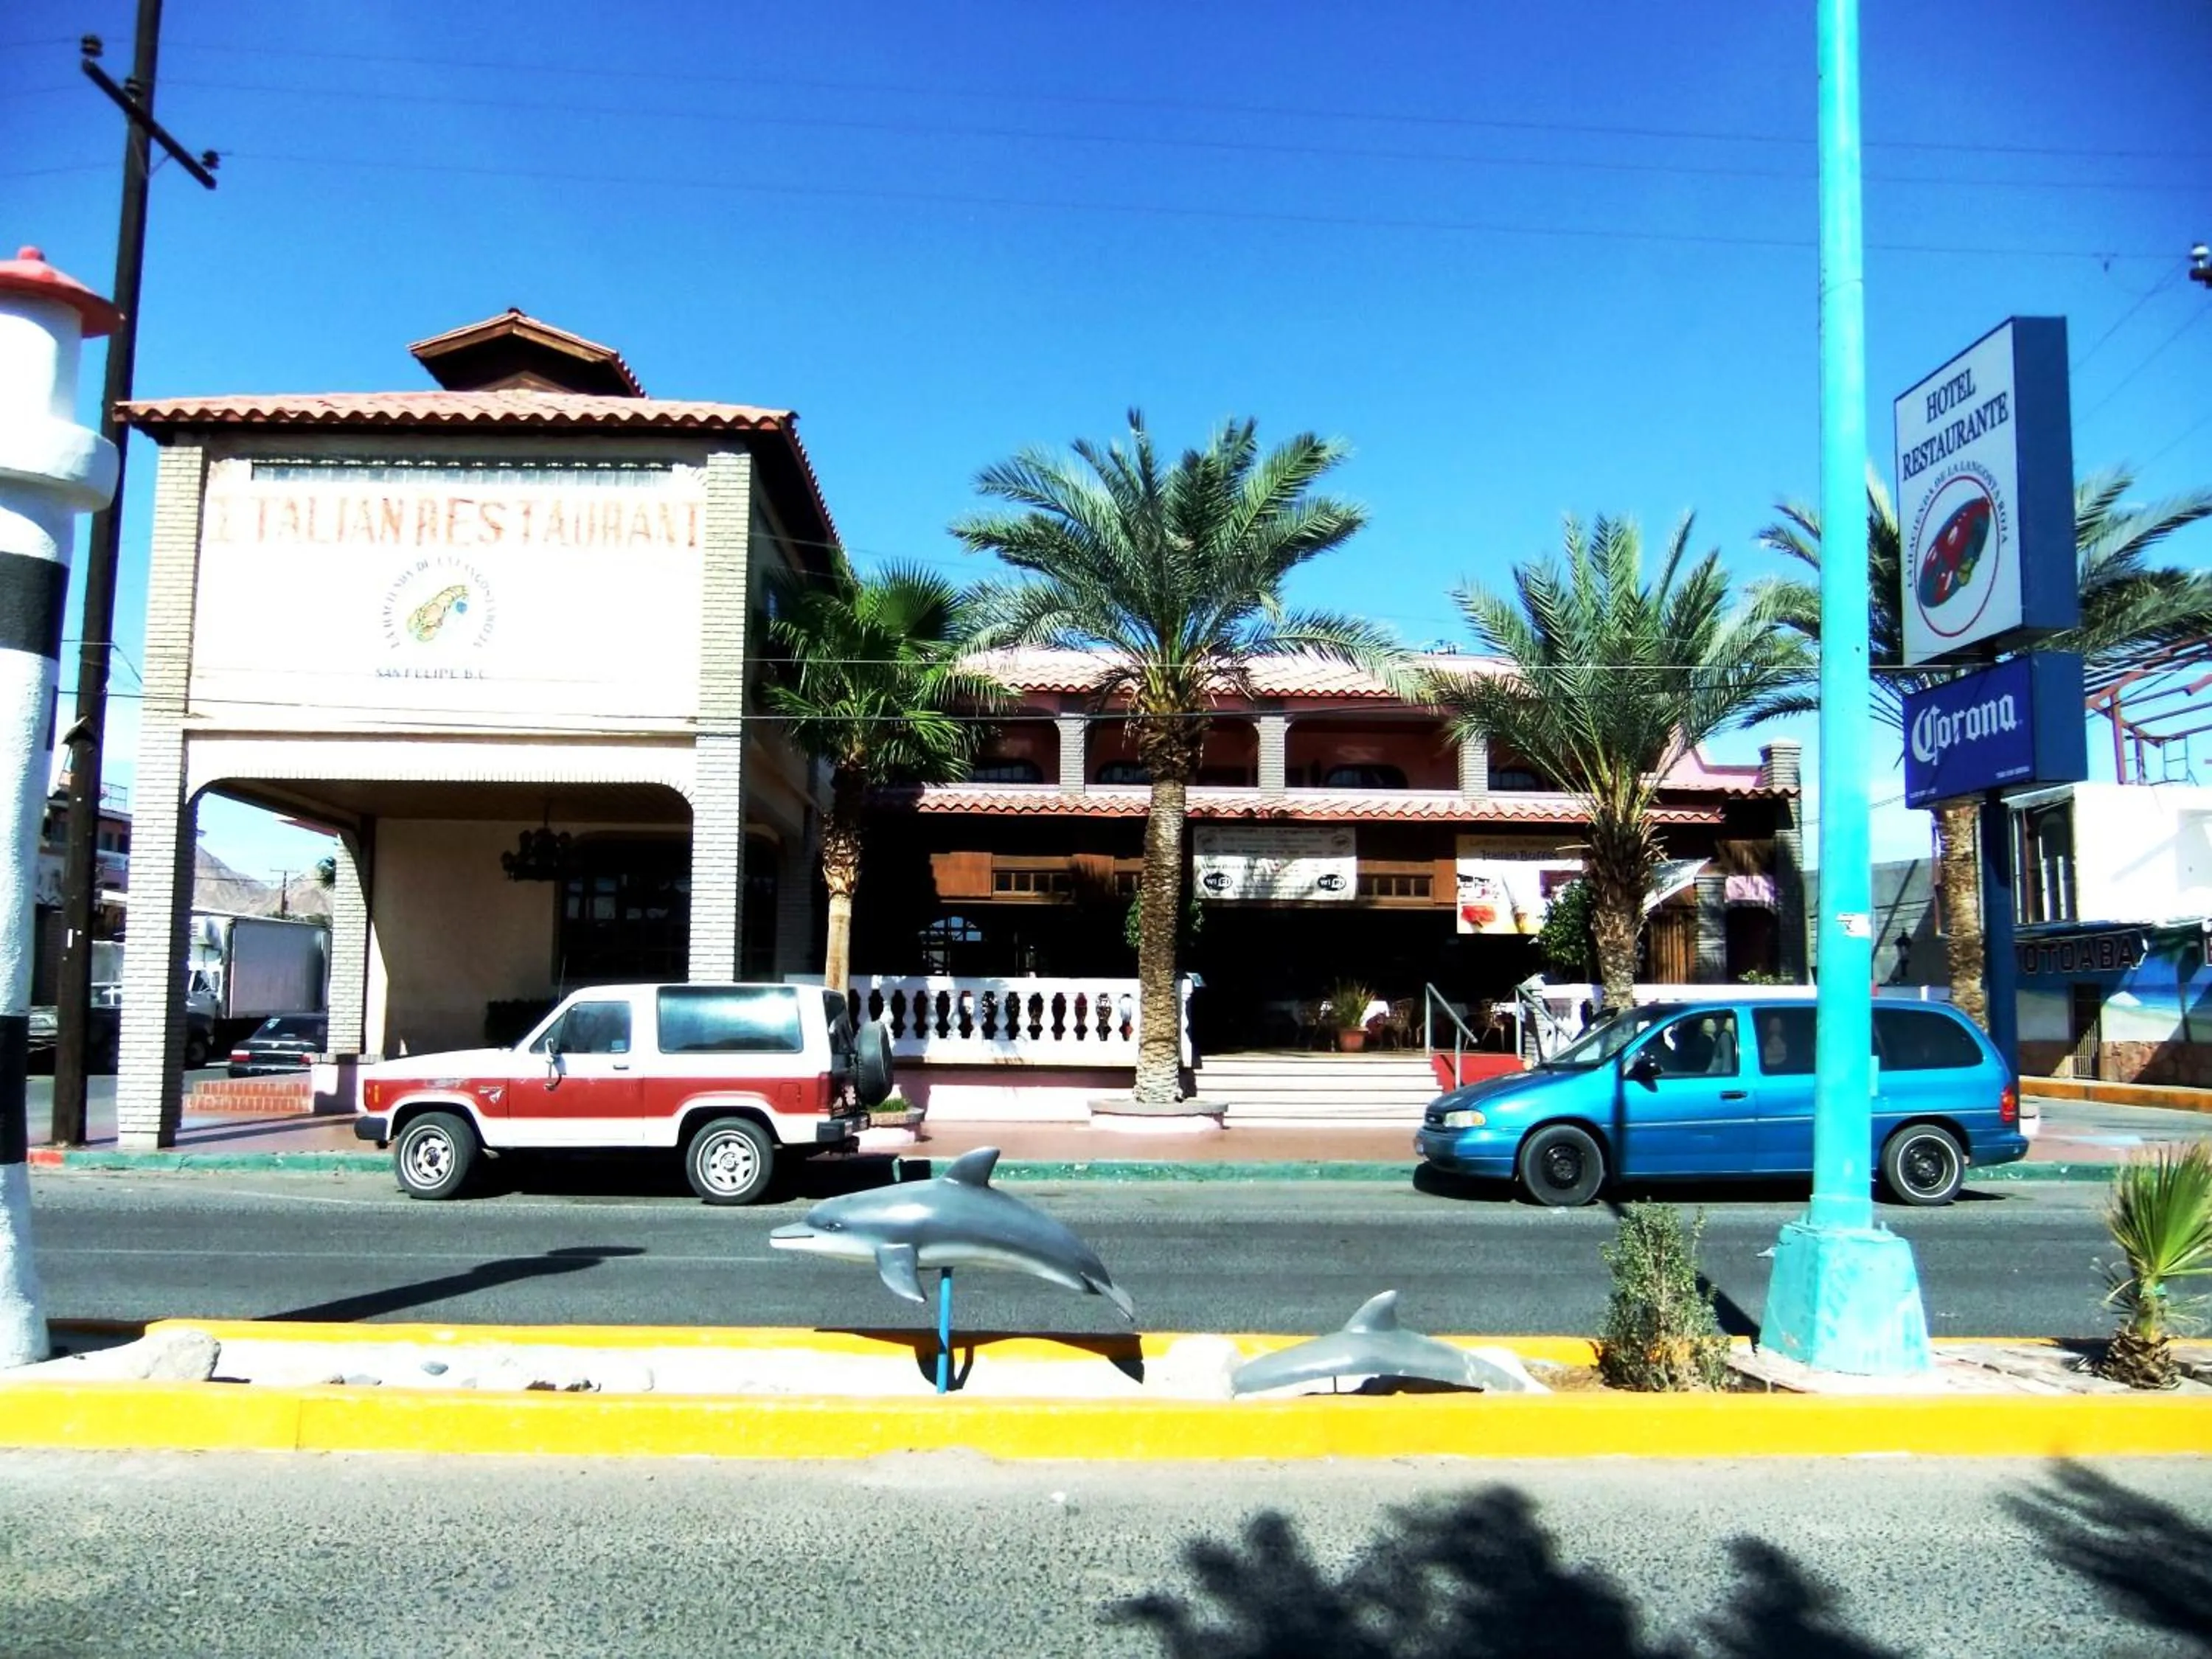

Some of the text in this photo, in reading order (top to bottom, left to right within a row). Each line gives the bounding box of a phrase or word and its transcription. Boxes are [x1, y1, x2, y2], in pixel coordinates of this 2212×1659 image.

[1926, 368, 1977, 424] HOTEL
[1902, 390, 2009, 482] RESTAURANTE
[209, 495, 701, 546] ITALIAN RESTAURANT
[1911, 694, 2018, 766] Corona
